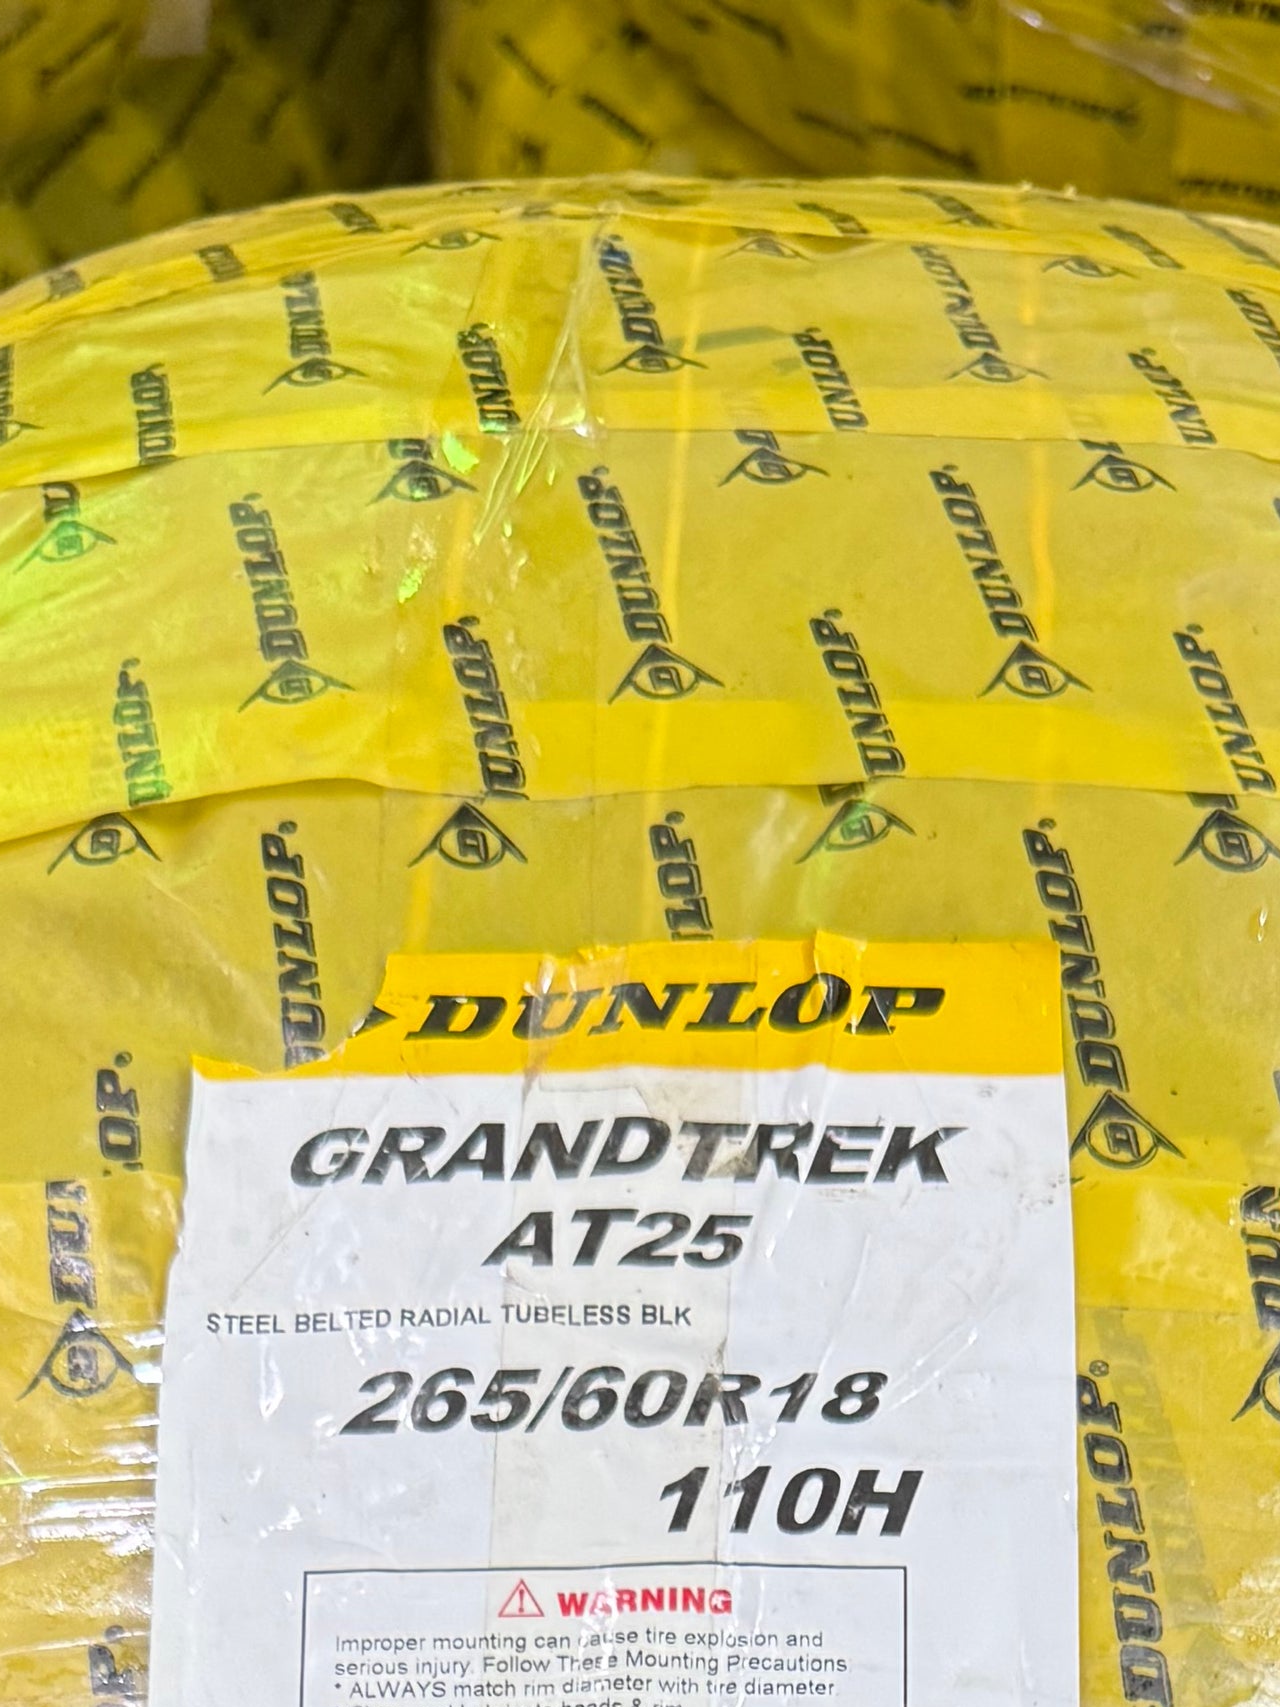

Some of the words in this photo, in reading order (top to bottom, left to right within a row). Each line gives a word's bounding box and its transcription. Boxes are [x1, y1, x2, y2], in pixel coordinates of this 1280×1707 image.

[131, 365, 176, 465] UNLOP
[229, 494, 308, 660] DUNLOP
[577, 465, 671, 643] DUNLOP
[930, 465, 1038, 640] DUNLOP
[443, 615, 528, 801] UNLOP
[649, 811, 713, 941] LOP
[1023, 817, 1130, 1093] DUNLOP
[403, 972, 946, 1041] DUNLOP
[290, 1114, 969, 1188] GRANDTREK
[481, 1208, 752, 1269] AT25
[206, 1313, 285, 1335] STEEL
[294, 1309, 392, 1334] BELTED
[400, 1306, 492, 1328] RADIAL
[501, 1304, 631, 1326] TUBELESS
[642, 1304, 692, 1326] BLK
[339, 1366, 888, 1436] 265/60R18
[660, 1465, 924, 1536] 110H
[1076, 1360, 1175, 1707] DUNLOP
[557, 1587, 732, 1617] WARNING
[335, 1659, 408, 1676] serious
[483, 1655, 550, 1673] Follow
[626, 1651, 718, 1675] Mounting
[336, 1635, 426, 1655] Improper
[433, 1633, 526, 1653] mounting
[534, 1635, 571, 1649] can
[646, 1627, 677, 1645] tire
[684, 1629, 779, 1649] explosion
[786, 1632, 823, 1648] and
[350, 1681, 447, 1699] ALWAYS
[454, 1679, 516, 1697] match
[524, 1681, 555, 1696] rim
[562, 1676, 652, 1694] diameter
[658, 1675, 699, 1694] with
[706, 1678, 737, 1694] tire
